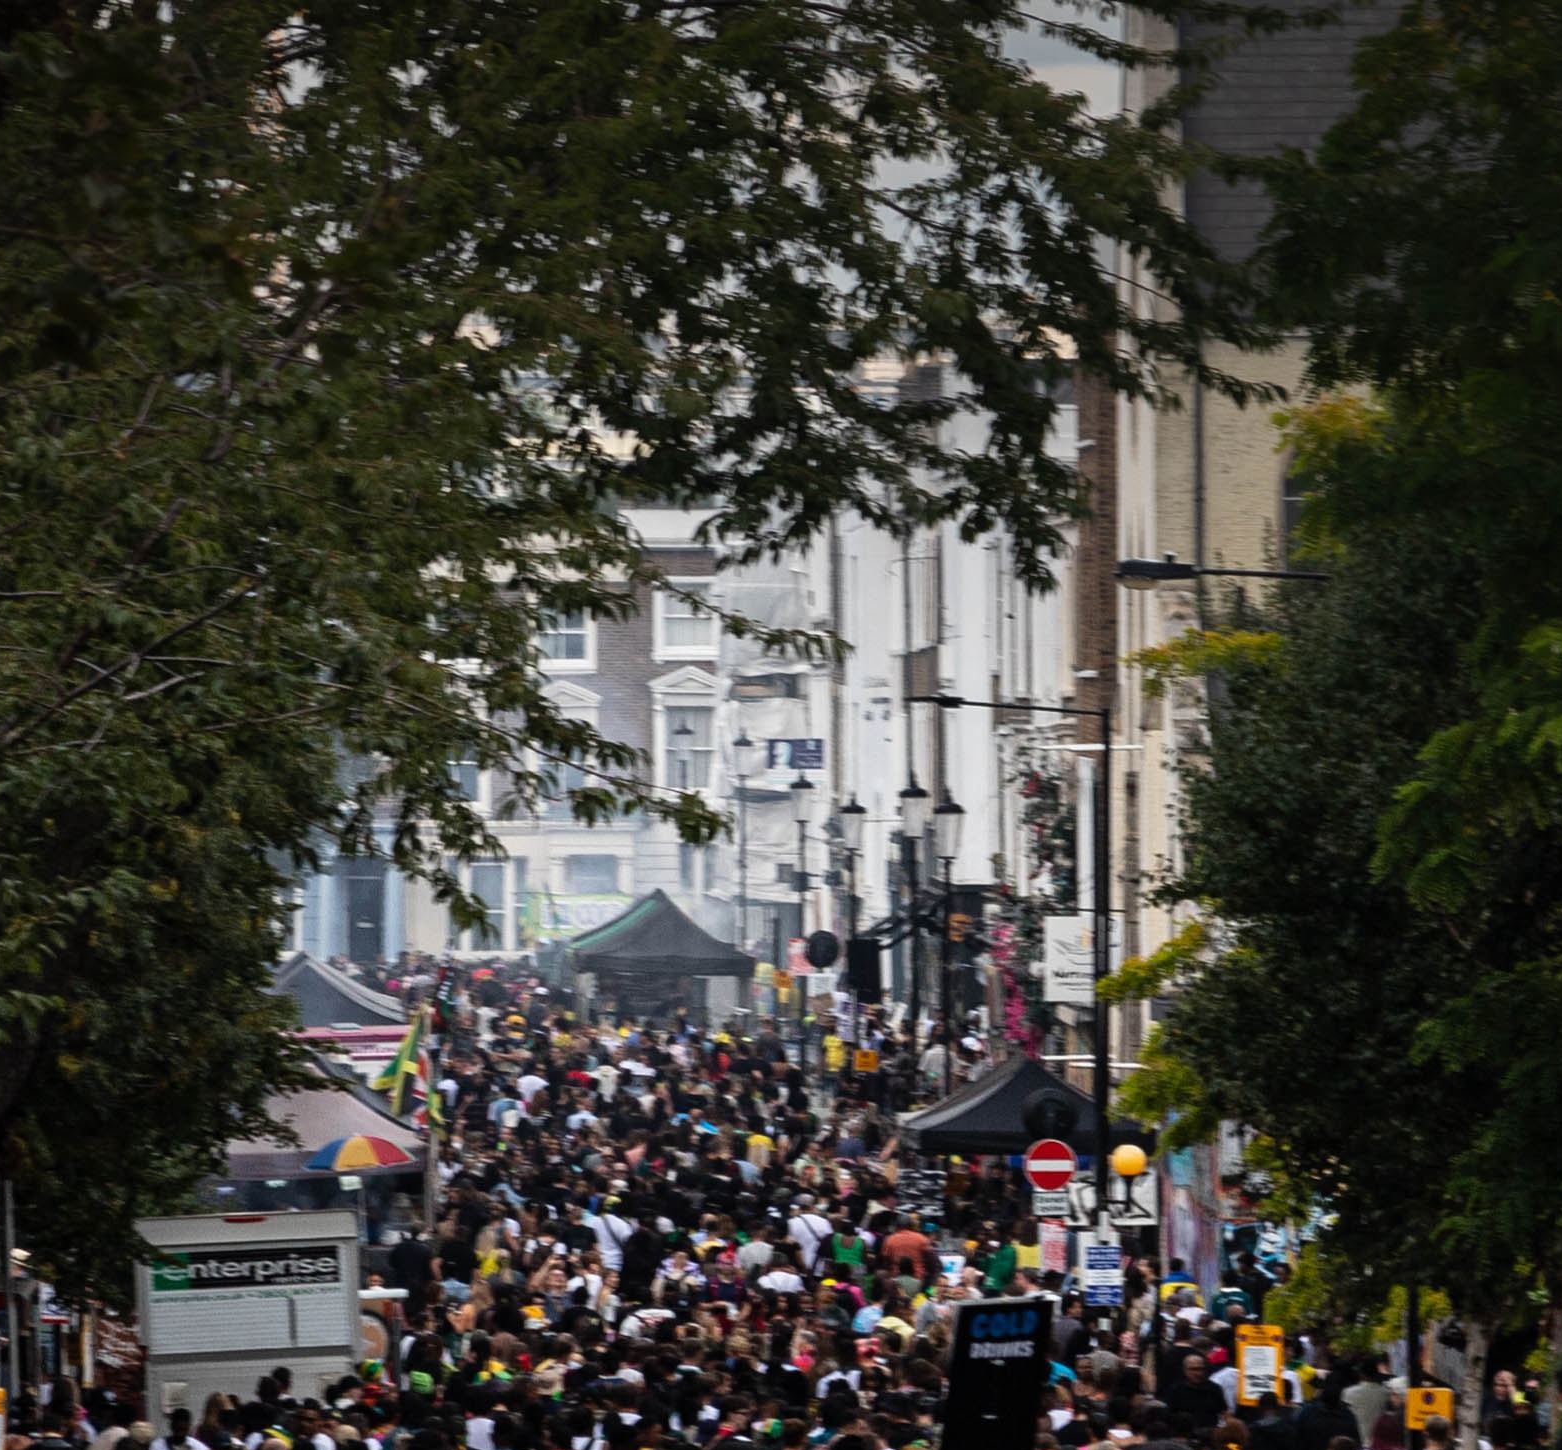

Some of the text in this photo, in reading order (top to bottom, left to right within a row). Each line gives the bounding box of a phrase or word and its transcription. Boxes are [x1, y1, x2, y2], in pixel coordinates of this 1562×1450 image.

[155, 1253, 337, 1283] enterprise
[969, 1308, 1039, 1339] COLD
[968, 1340, 1036, 1360] DRINKS
